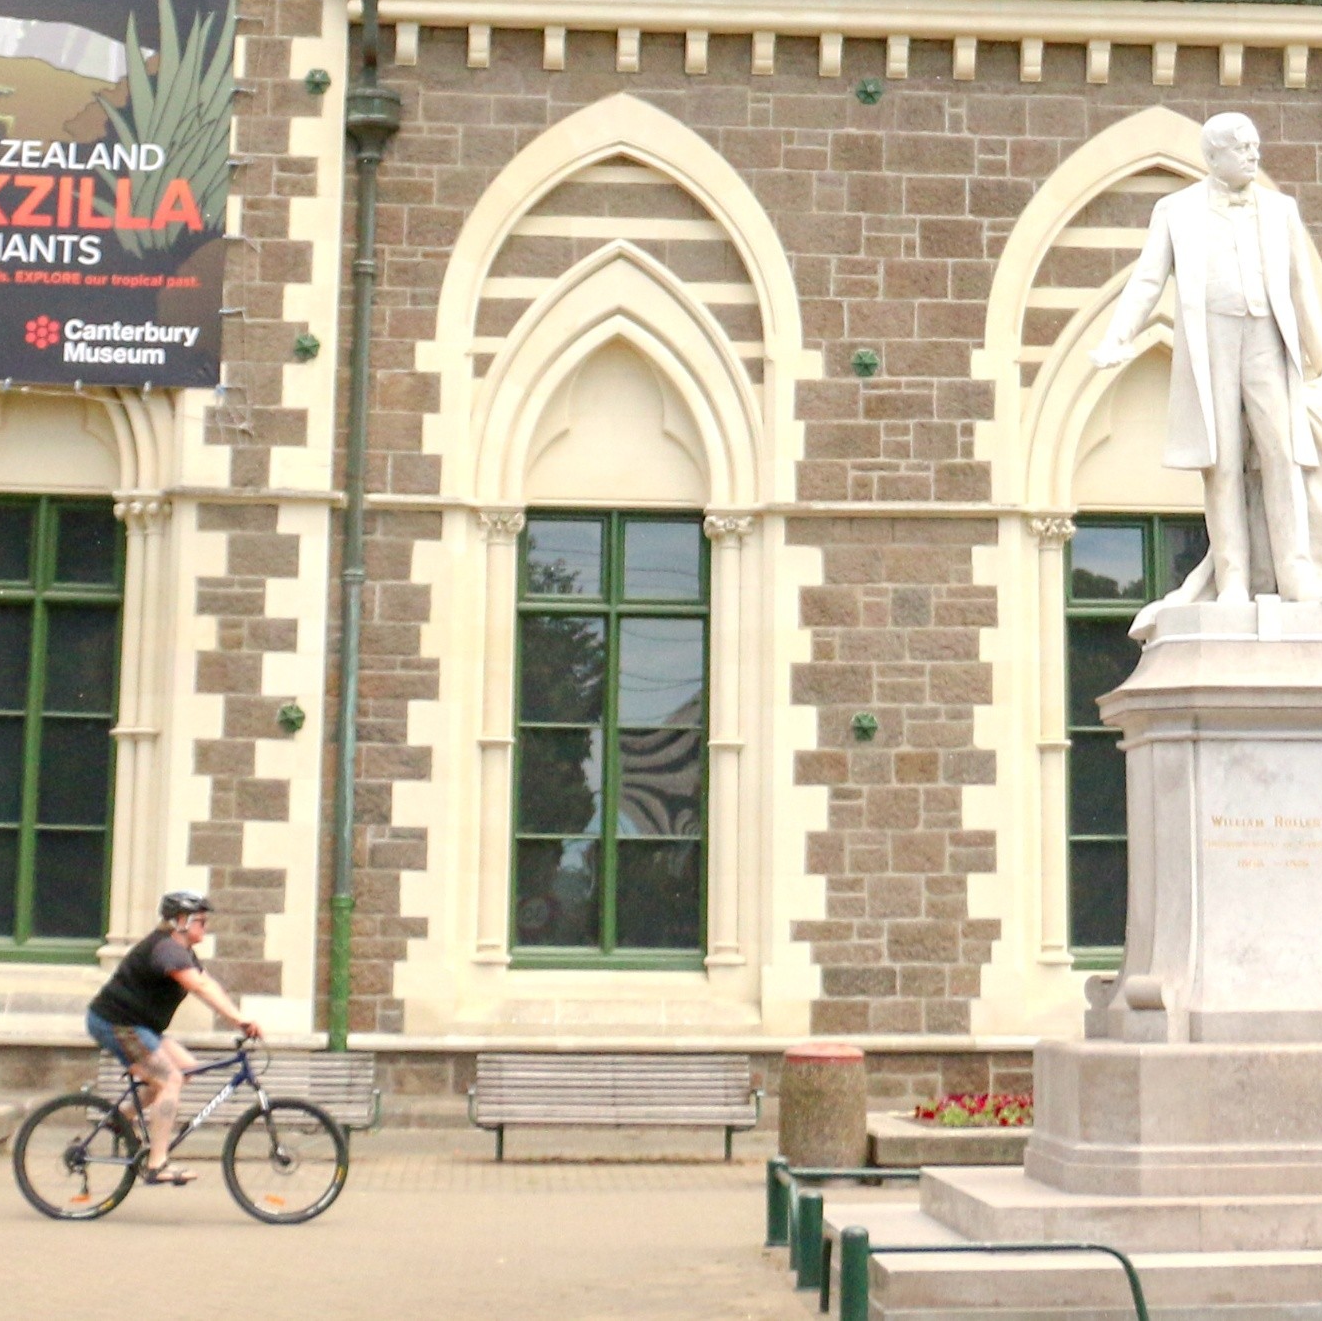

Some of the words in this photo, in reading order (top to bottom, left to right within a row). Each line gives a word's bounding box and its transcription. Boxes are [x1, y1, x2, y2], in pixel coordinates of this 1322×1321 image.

[0, 139, 166, 172] ZEALAND
[14, 270, 83, 286] EXPLORE
[84, 275, 108, 287] our
[111, 273, 164, 289] tropical
[64, 318, 200, 347] Canterbury
[63, 342, 166, 365] Museum
